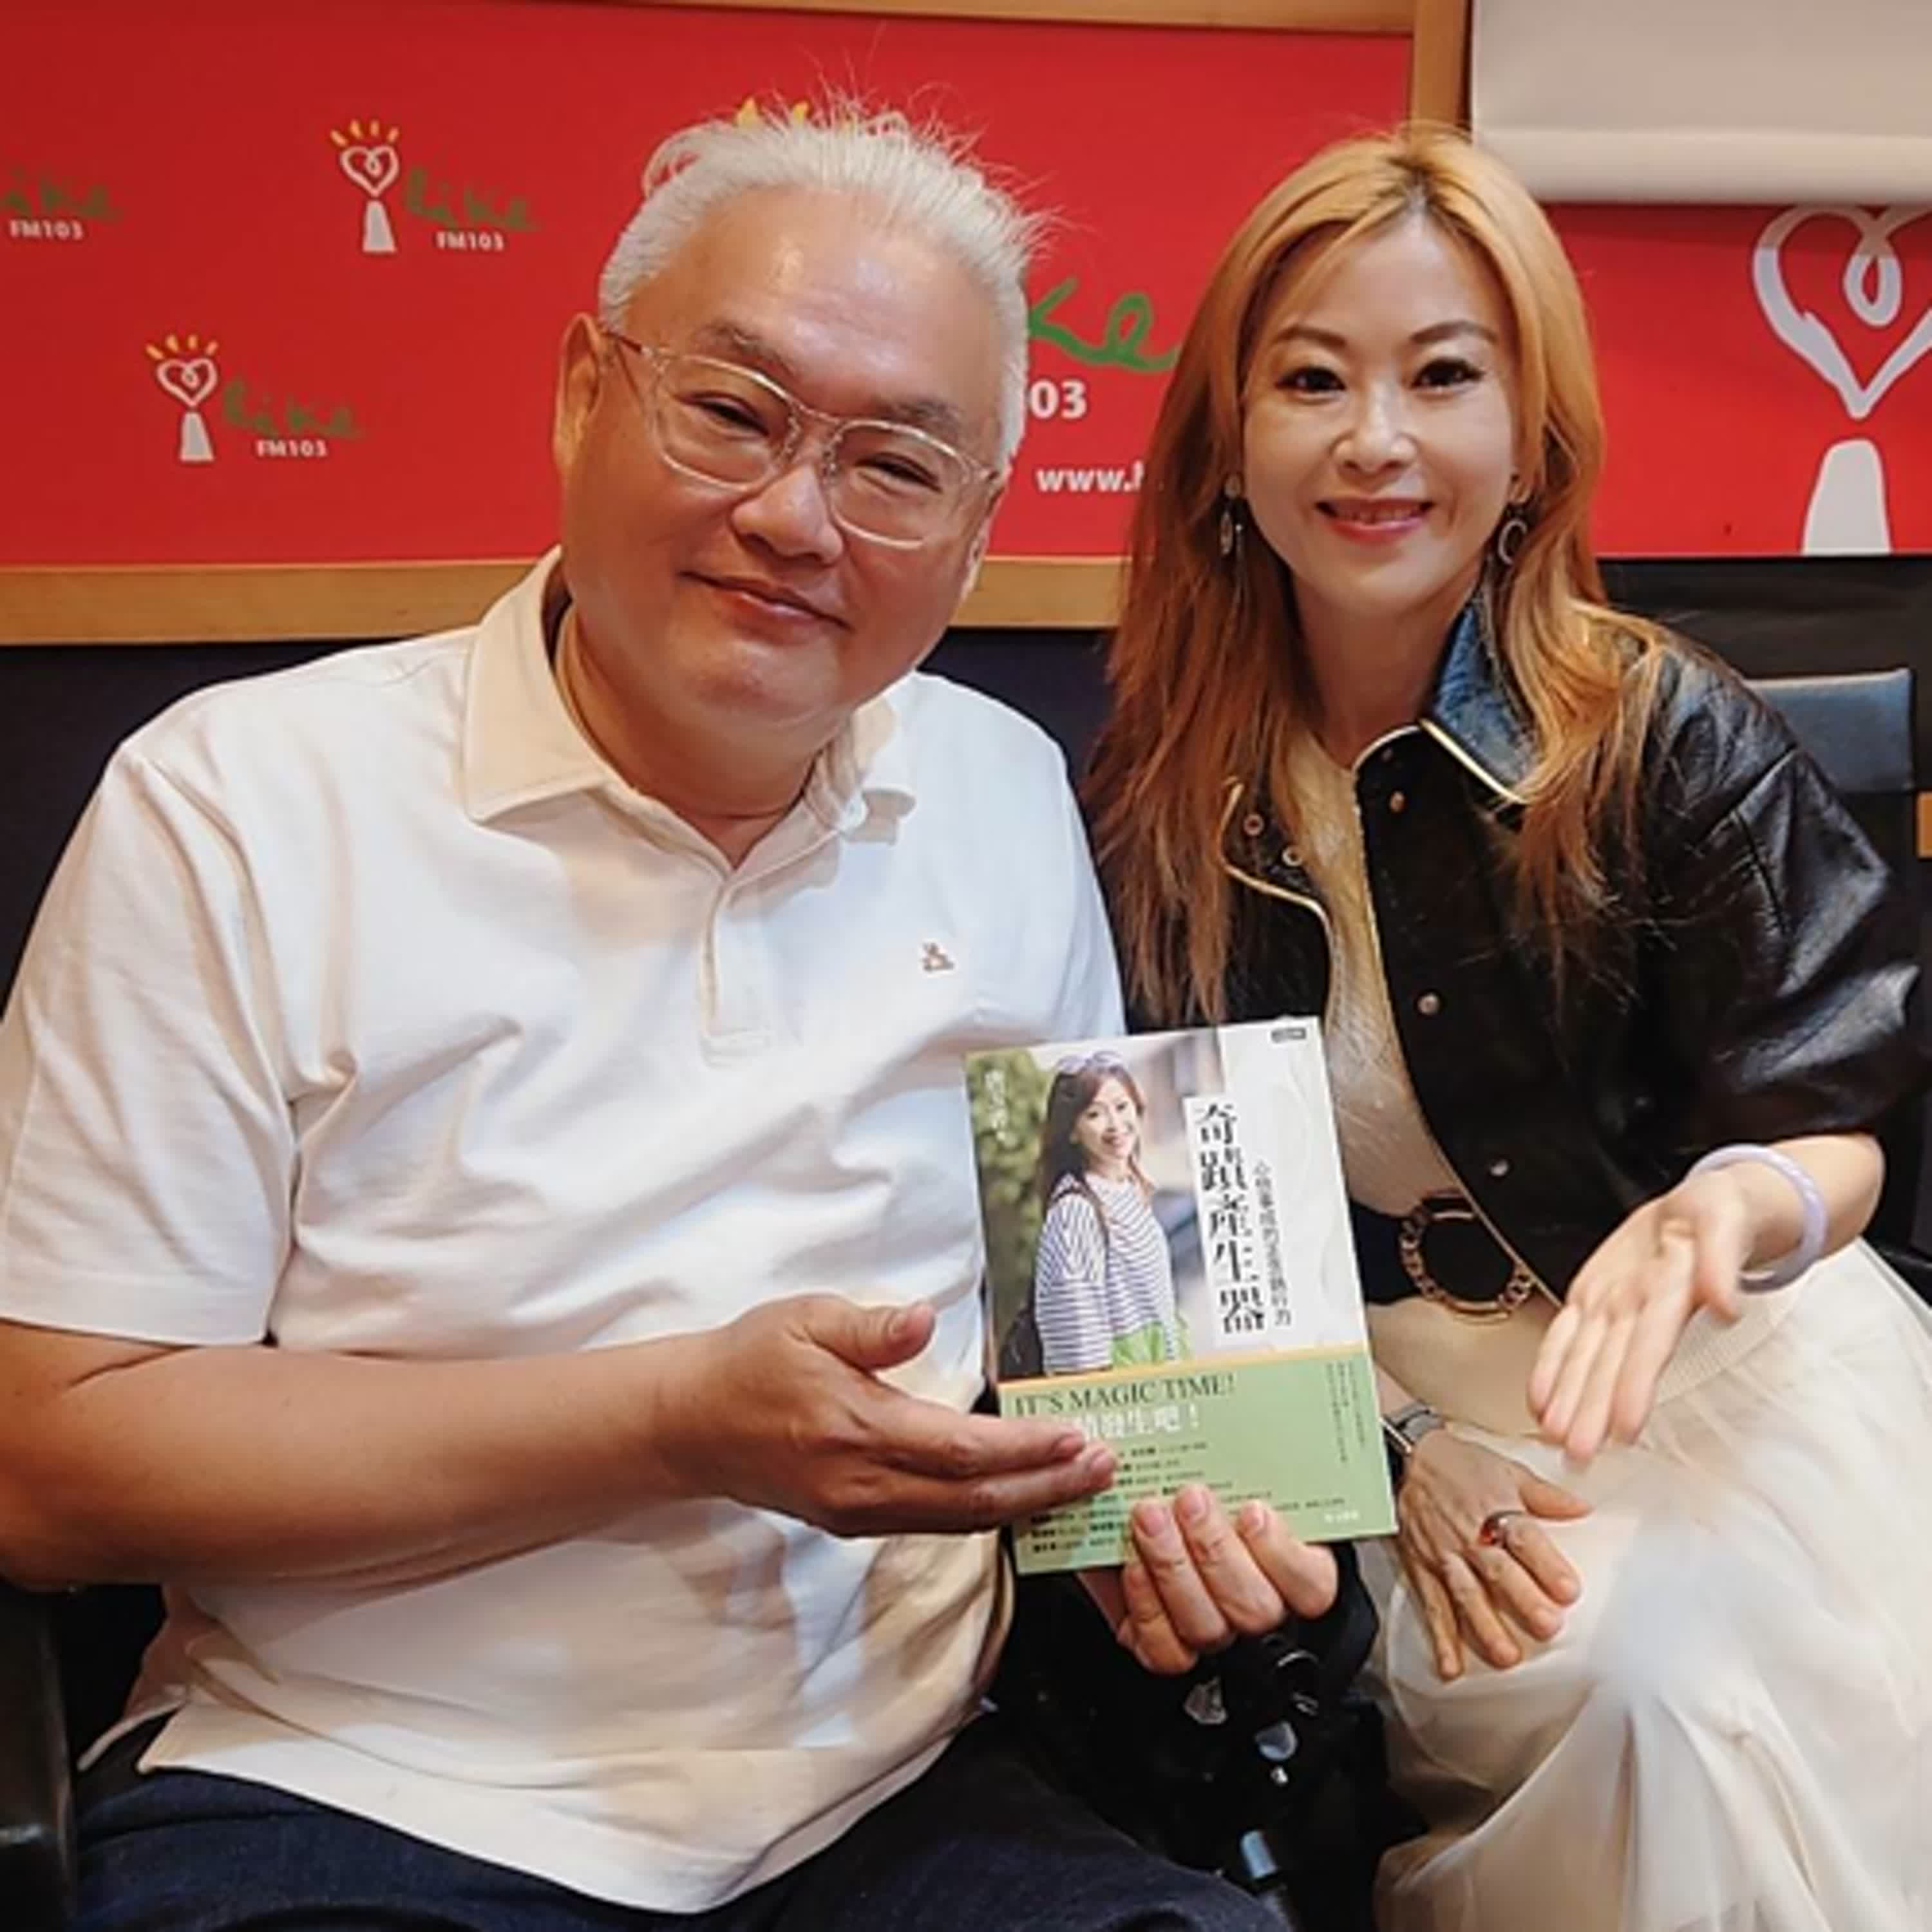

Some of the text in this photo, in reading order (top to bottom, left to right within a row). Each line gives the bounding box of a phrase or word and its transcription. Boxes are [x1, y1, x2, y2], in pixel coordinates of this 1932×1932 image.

[10, 219, 84, 241] FM103
[435, 231, 504, 251] FM103
[256, 439, 328, 457] FM103
[1068, 1381, 1155, 1410] MAGIC
[1163, 1372, 1235, 1401] TIME!
